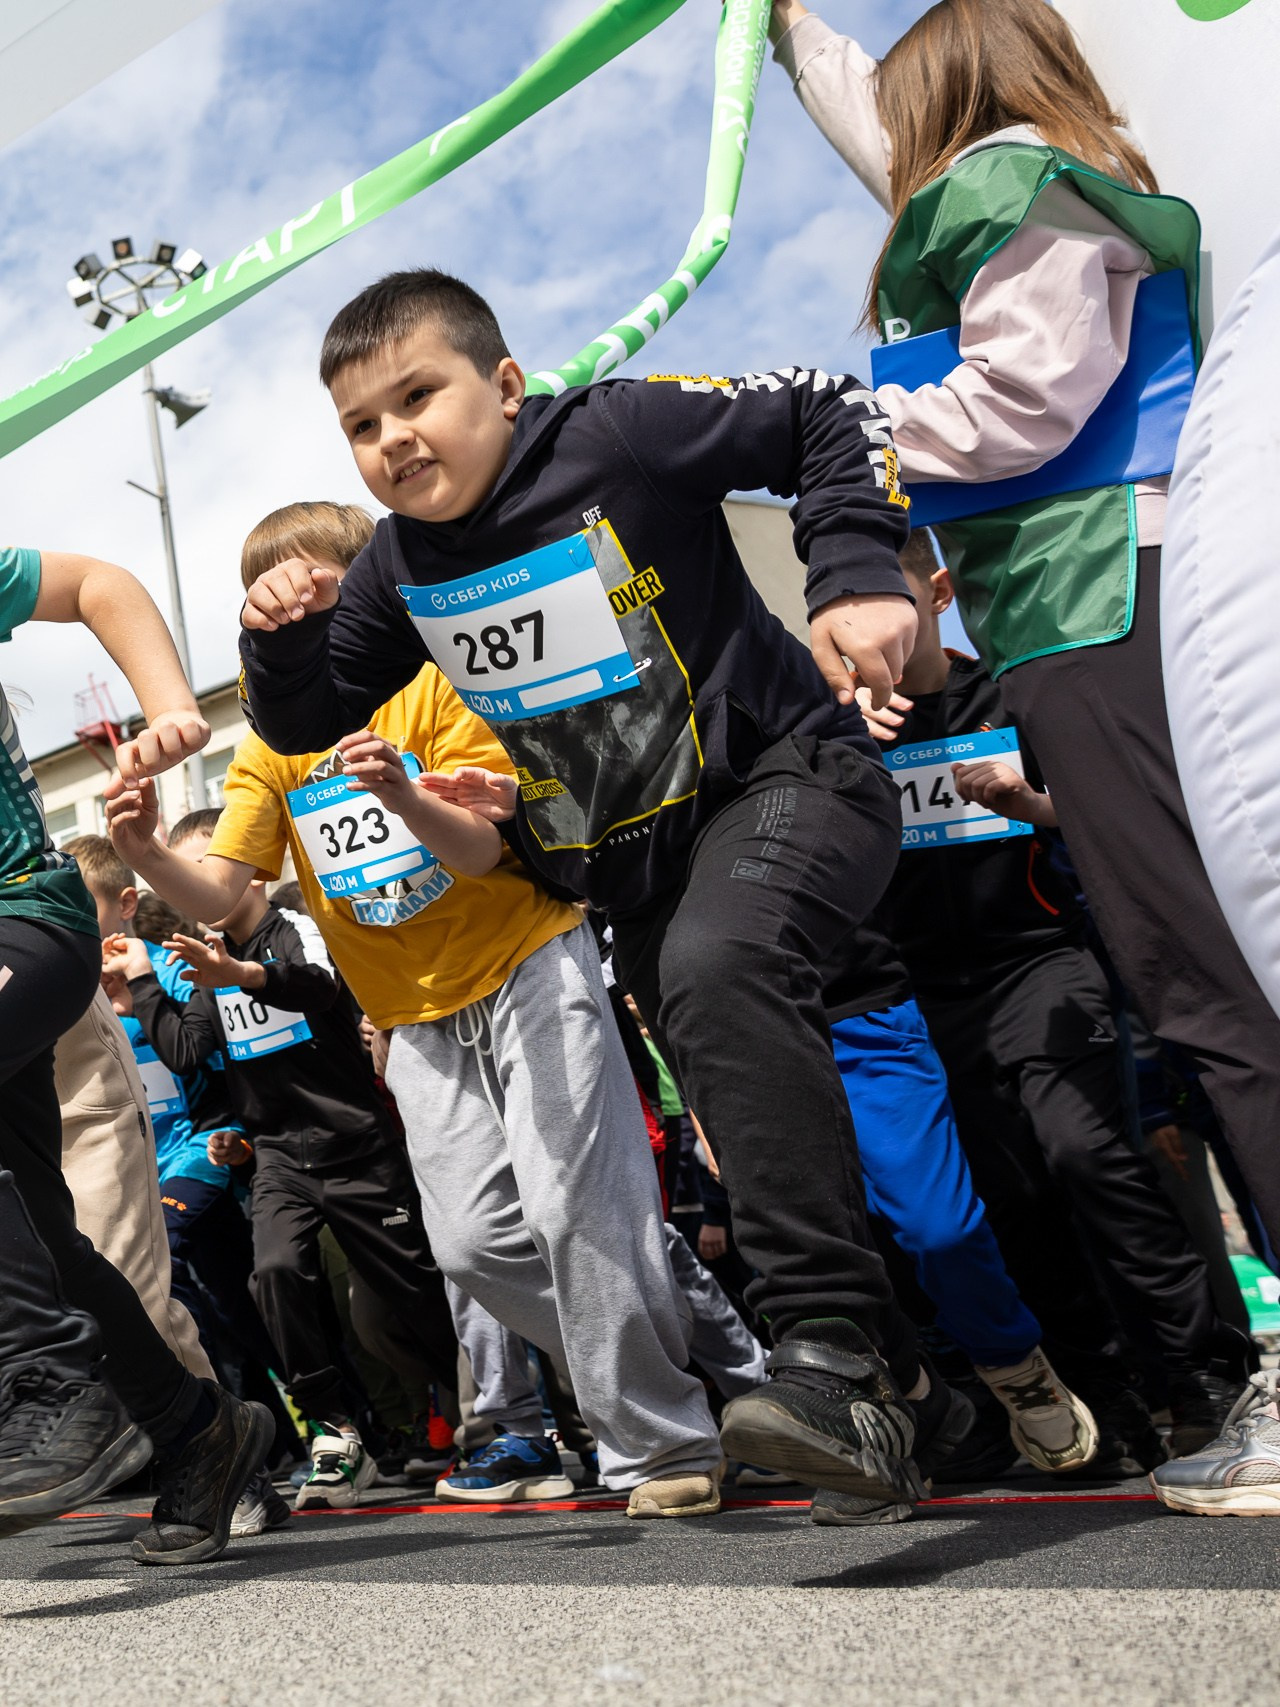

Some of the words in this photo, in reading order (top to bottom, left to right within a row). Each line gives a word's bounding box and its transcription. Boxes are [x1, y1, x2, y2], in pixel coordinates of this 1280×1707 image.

[582, 505, 602, 526] OFF
[447, 583, 488, 606] СБЕР
[490, 567, 531, 592] KIDS
[607, 571, 663, 616] OVER
[452, 609, 545, 676] 287
[909, 747, 943, 761] СБЕР
[945, 742, 975, 754] KIDS
[316, 783, 346, 801] СБЕР
[537, 782, 564, 798] CROSS
[902, 775, 972, 814] 14
[319, 807, 390, 858] 323
[329, 874, 346, 892] 420
[354, 870, 452, 923] ПОГНАЛИ
[224, 999, 269, 1032] 310
